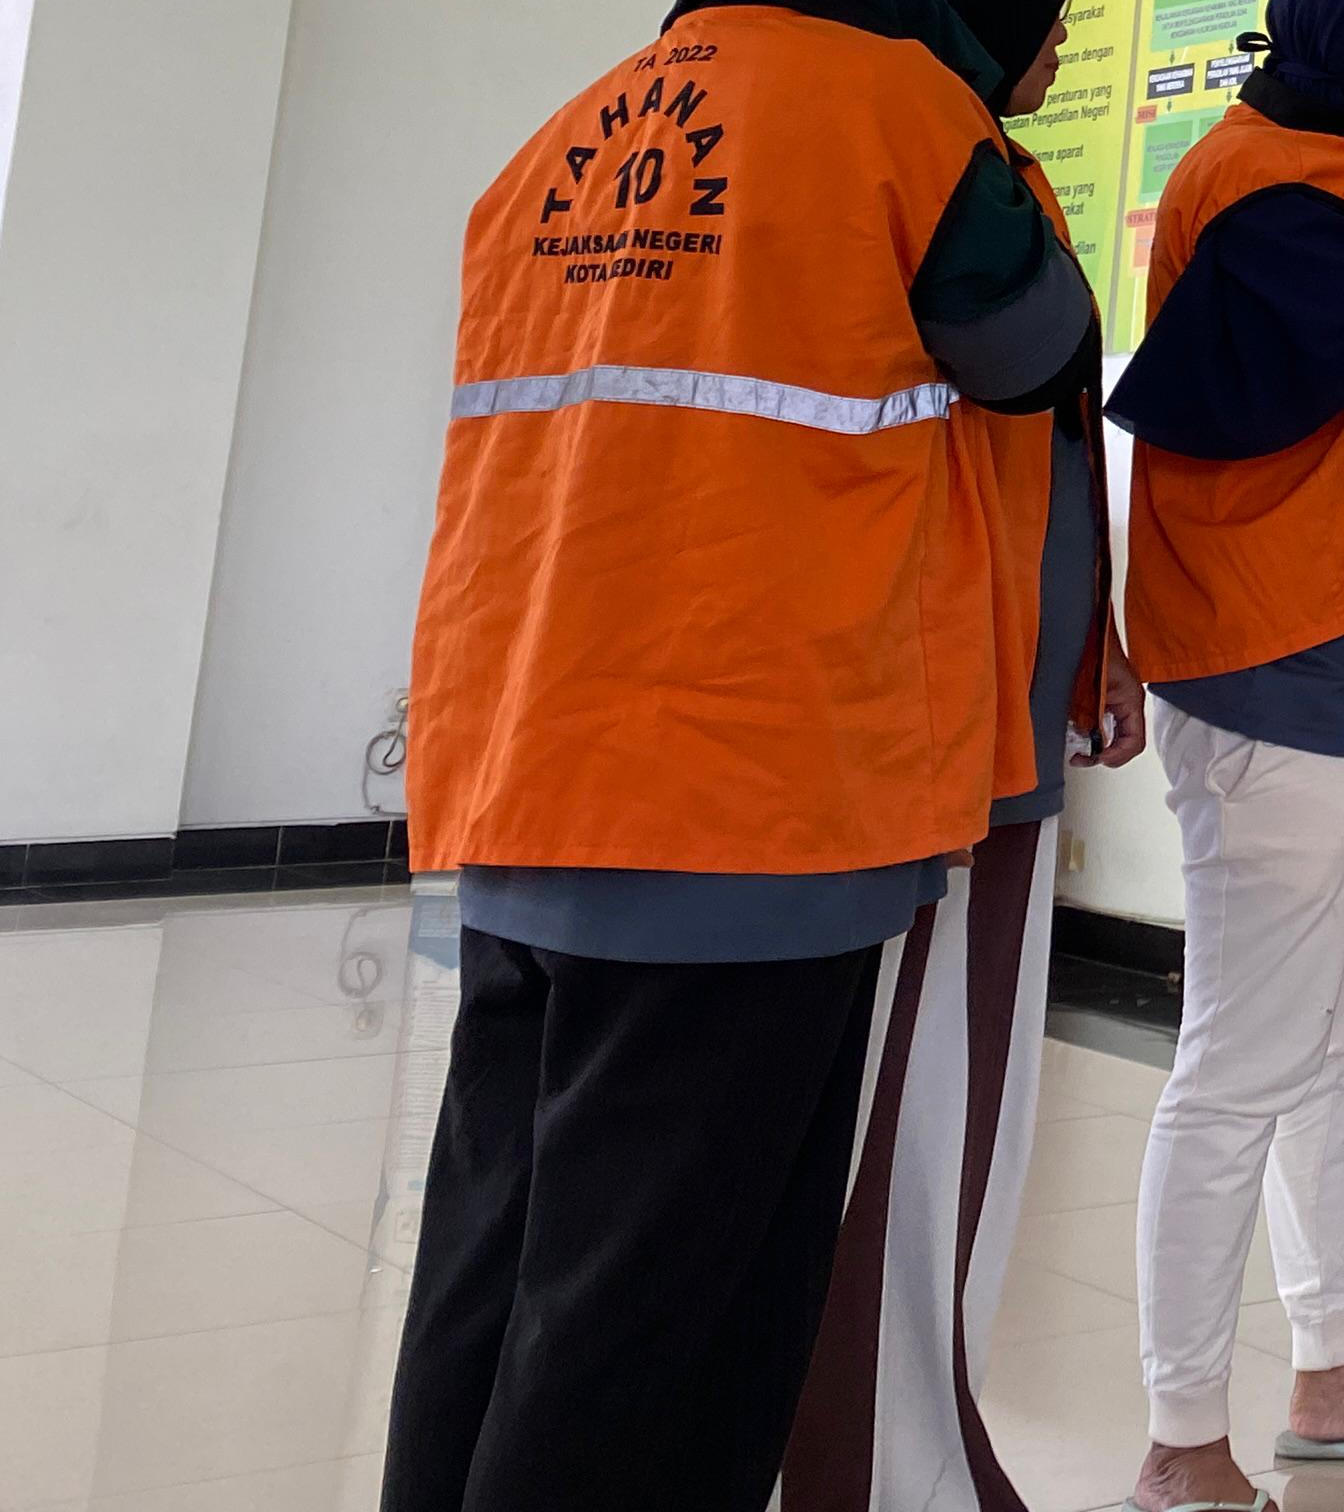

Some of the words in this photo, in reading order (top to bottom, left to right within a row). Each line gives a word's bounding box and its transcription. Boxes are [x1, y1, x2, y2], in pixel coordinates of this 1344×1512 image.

[634, 53, 657, 73] TA
[664, 45, 717, 66] 2022
[1081, 46, 1114, 62] dengan
[1047, 88, 1088, 108] peraturan
[1090, 84, 1112, 102] yang
[1032, 108, 1079, 128] Pengadilan
[1081, 101, 1110, 121] Negeri
[540, 76, 728, 224] TAHANAN
[1056, 144, 1084, 163] aparat
[614, 148, 664, 209] 10
[1072, 183, 1095, 199] yang
[1062, 202, 1084, 216] rakat
[631, 228, 723, 255] NEGERI
[564, 262, 607, 284] KOTA
[608, 257, 674, 281] EDIRI
